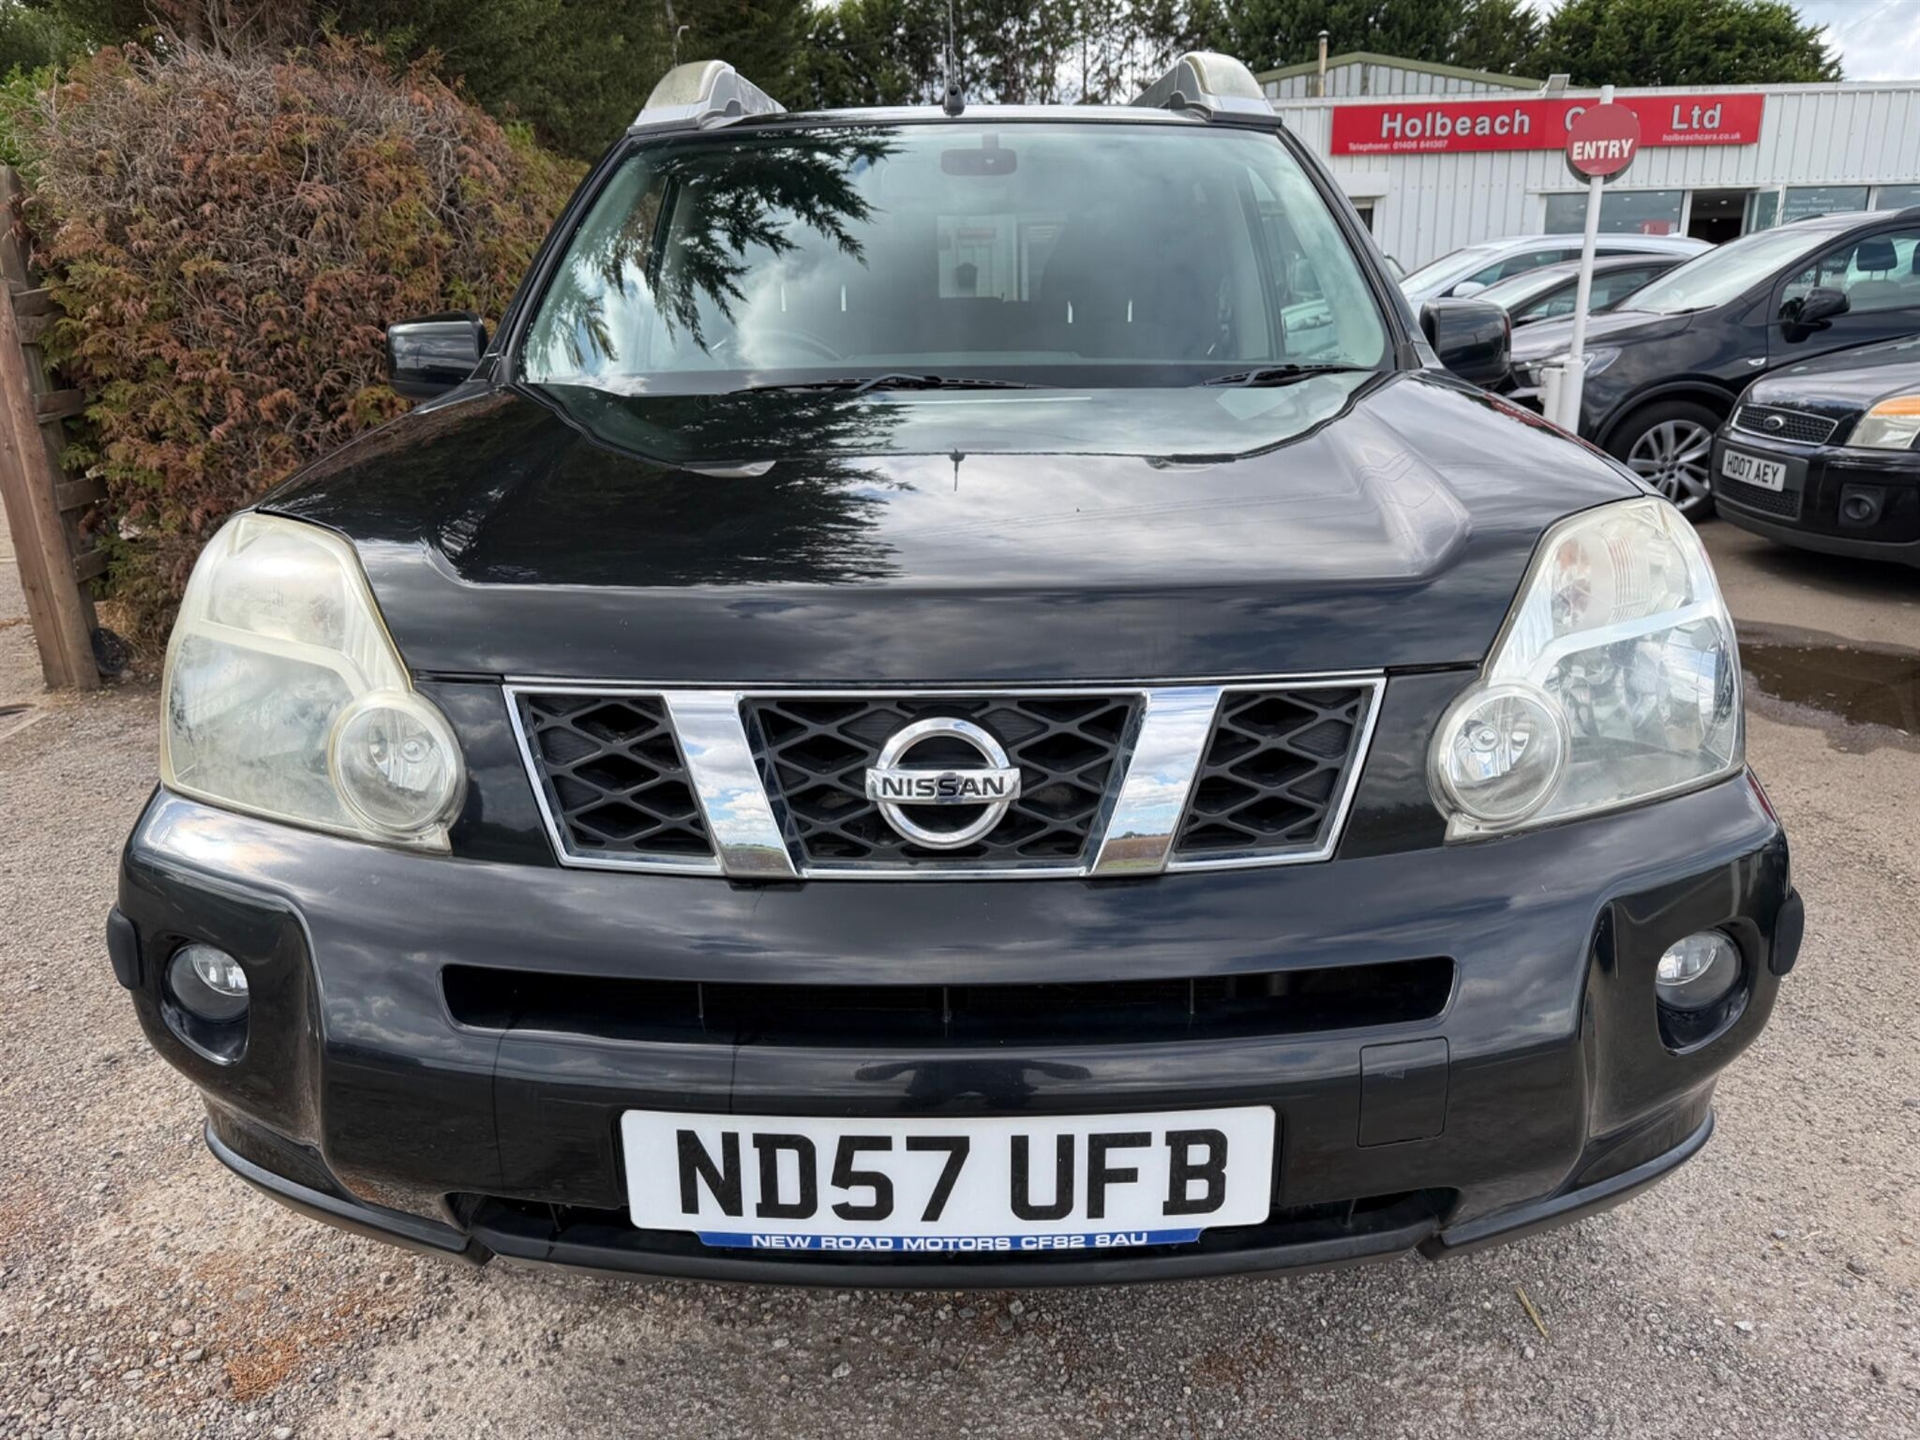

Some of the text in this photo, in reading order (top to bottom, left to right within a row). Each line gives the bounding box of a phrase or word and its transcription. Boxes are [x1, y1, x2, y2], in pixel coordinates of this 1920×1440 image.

[1381, 103, 1721, 138] Holbeach Ltd
[1662, 131, 1741, 142] holbeachcars.co.uk
[1572, 138, 1634, 160] ENTRY
[1754, 461, 1780, 485] AEY
[881, 776, 1004, 797] NISSAN
[675, 1128, 1228, 1222] ND57 UFB
[751, 1232, 1148, 1251] NEW ROAD MOTORS CF82 8AU
